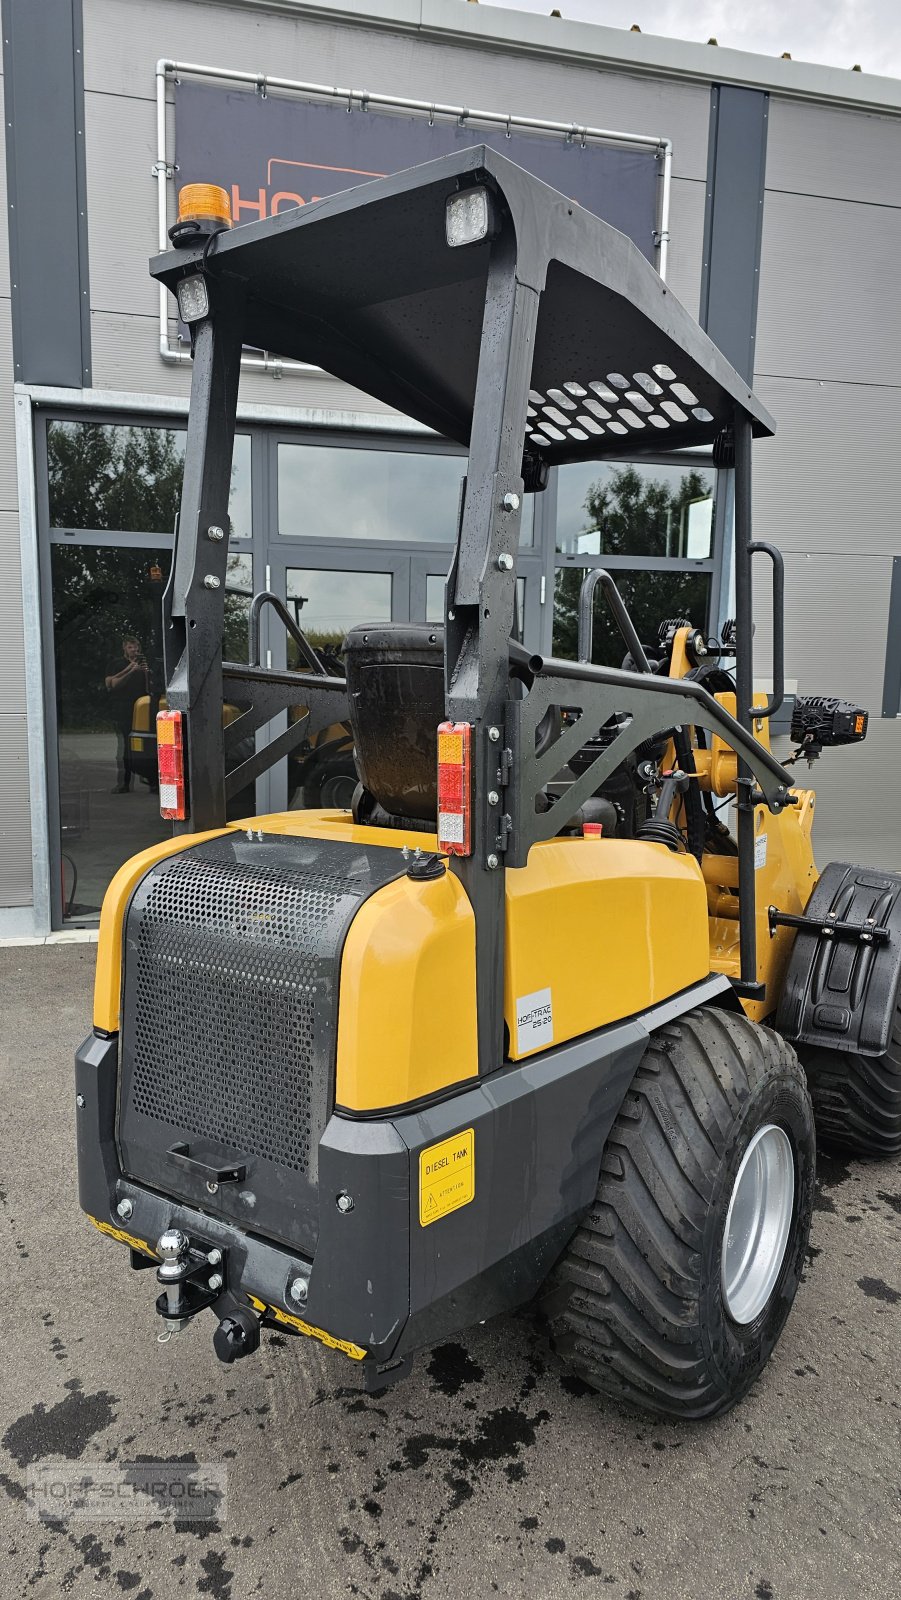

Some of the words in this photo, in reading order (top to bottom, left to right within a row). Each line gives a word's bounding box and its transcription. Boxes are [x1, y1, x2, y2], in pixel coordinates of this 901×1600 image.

[425, 1157, 449, 1175] DIESEL
[452, 1148, 468, 1162] TANK
[439, 1181, 465, 1197] ATTENTION
